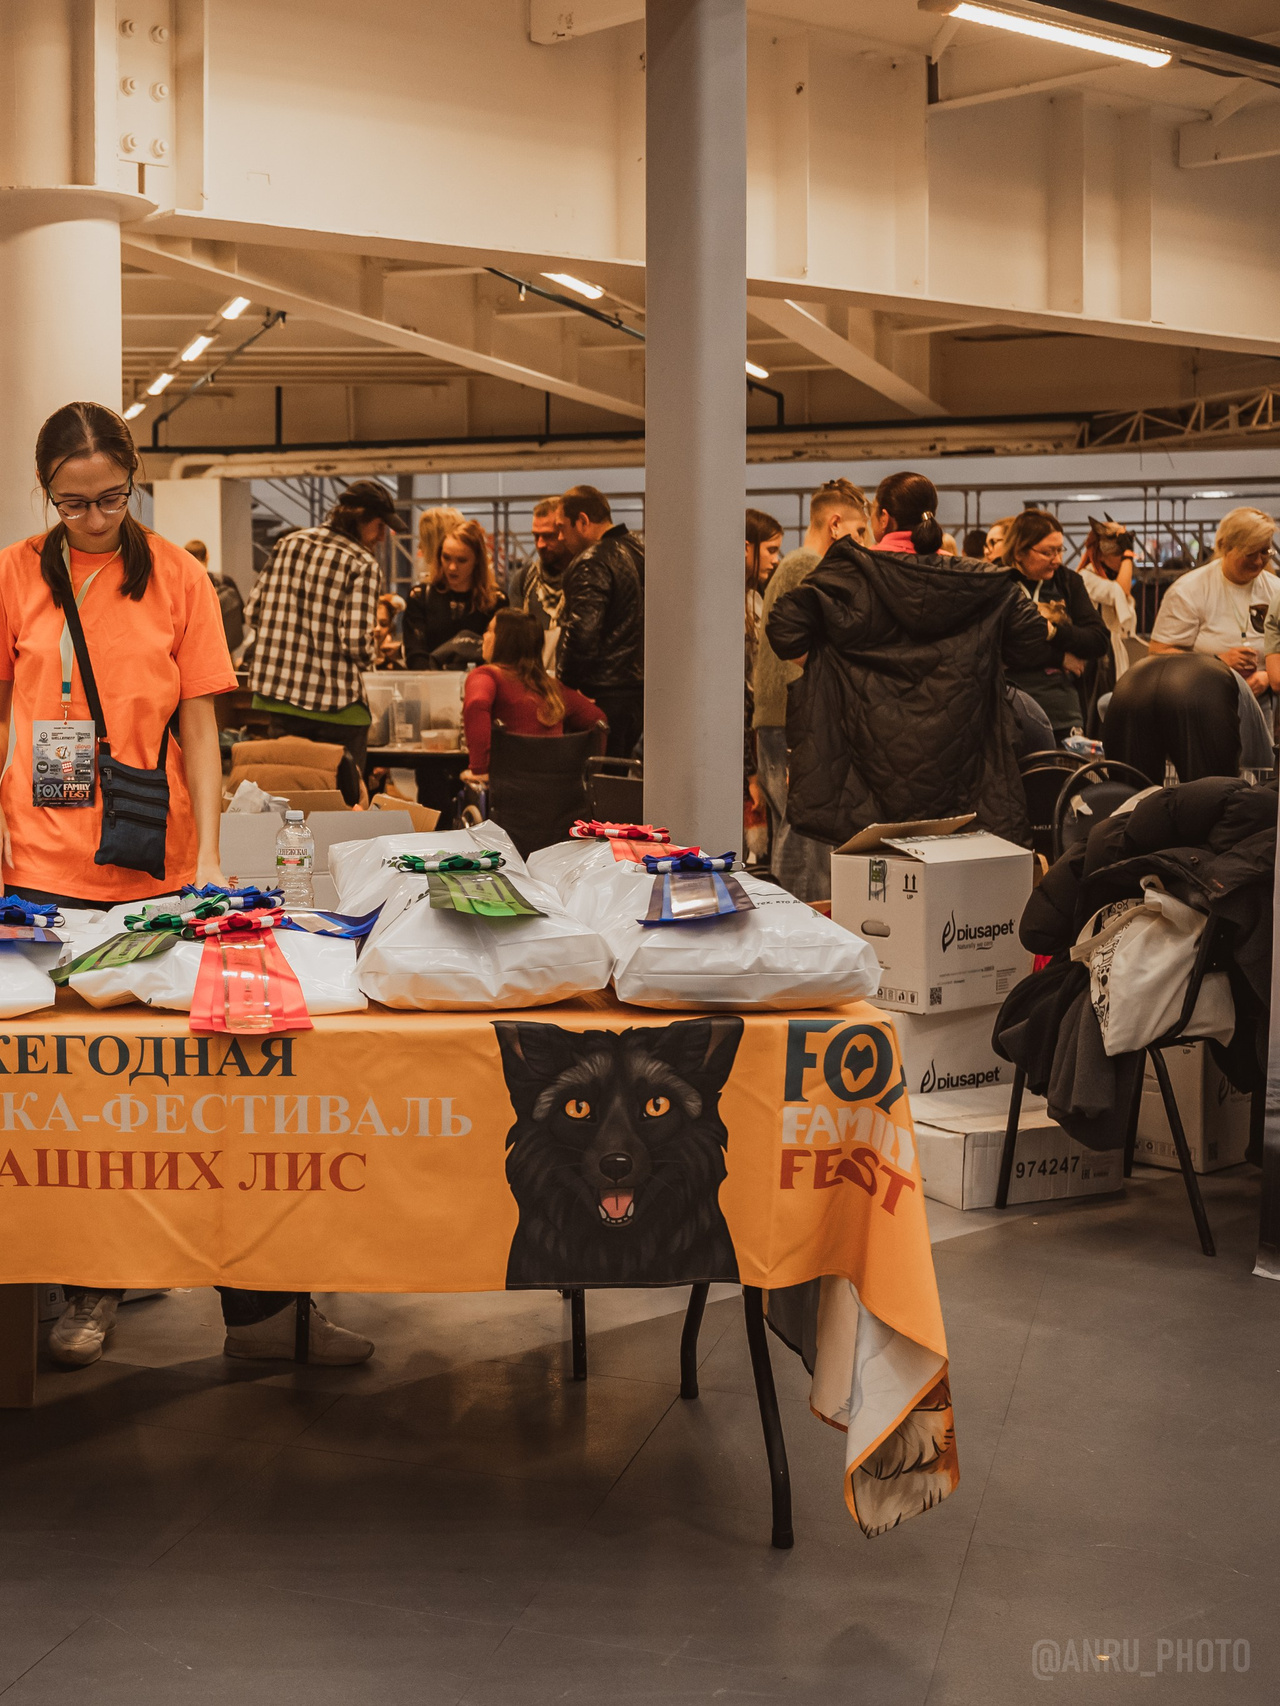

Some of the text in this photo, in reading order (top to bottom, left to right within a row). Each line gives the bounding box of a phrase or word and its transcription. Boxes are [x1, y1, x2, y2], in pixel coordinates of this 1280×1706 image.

[36, 783, 63, 798] FOX
[63, 783, 90, 791] FAMILY
[63, 790, 91, 798] FEST
[782, 1104, 916, 1175] FAMILY
[238, 1152, 368, 1193] ЛИС
[1015, 1156, 1081, 1179] 974247
[780, 1147, 916, 1217] FEST
